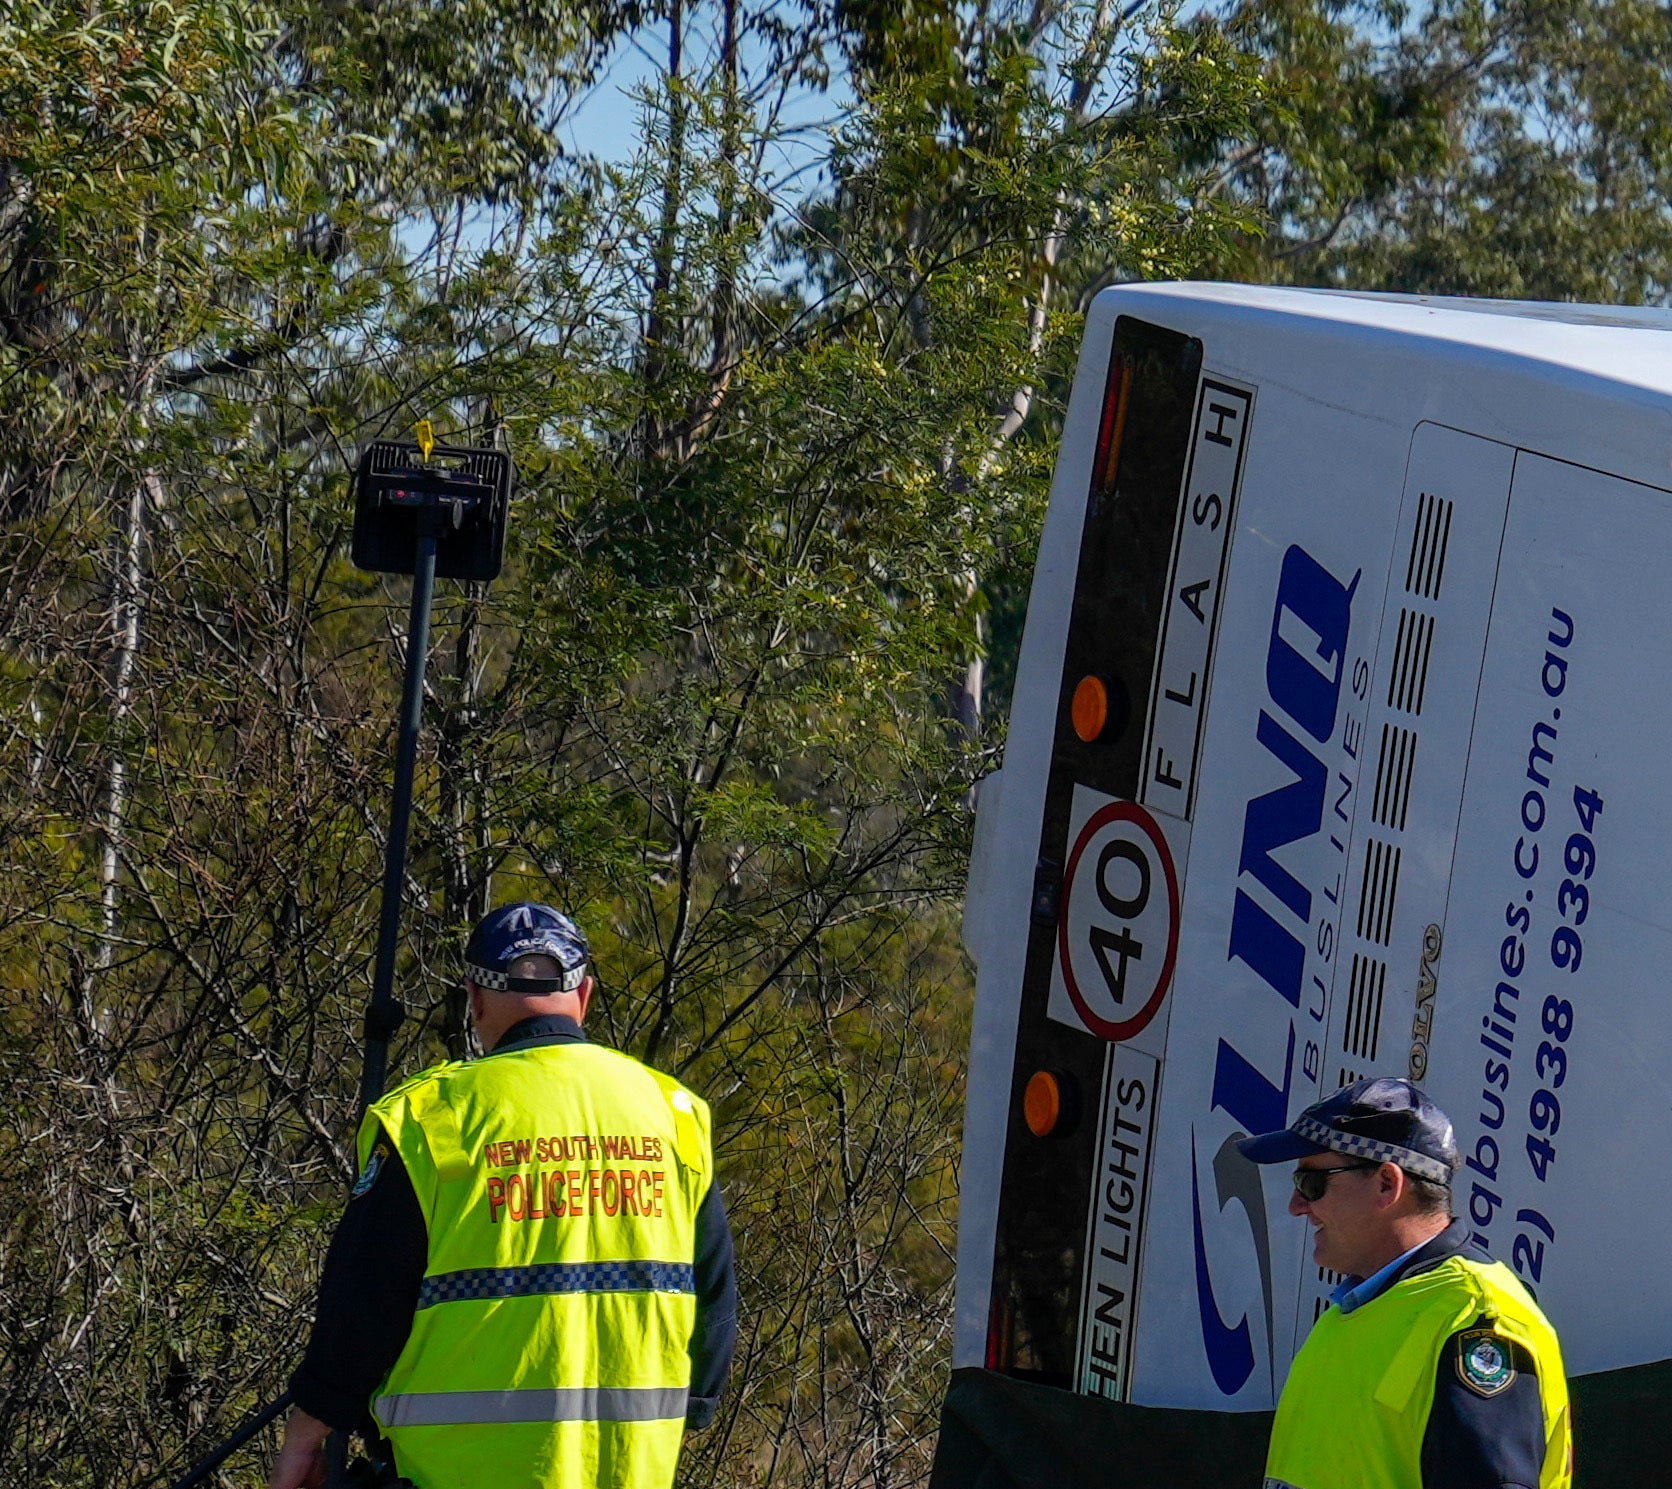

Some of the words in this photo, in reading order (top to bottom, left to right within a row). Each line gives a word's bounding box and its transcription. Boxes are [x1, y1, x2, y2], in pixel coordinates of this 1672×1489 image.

[1154, 402, 1238, 791] FLASH
[1088, 838, 1151, 1005] 40
[1302, 653, 1371, 1086] BUSLINES
[1550, 783, 1604, 975] 9394
[1410, 923, 1443, 1083] OLVO
[484, 1138, 531, 1168] NEW
[536, 1135, 599, 1162] SOUTH
[600, 1135, 663, 1162] WALES
[1100, 1077, 1146, 1266] LIGHTS
[1525, 993, 1574, 1183] 4938
[486, 1169, 584, 1224] POLICE
[588, 1168, 665, 1218] FORCE
[1513, 1207, 1557, 1303] 2)
[1087, 1281, 1126, 1401] HEN
